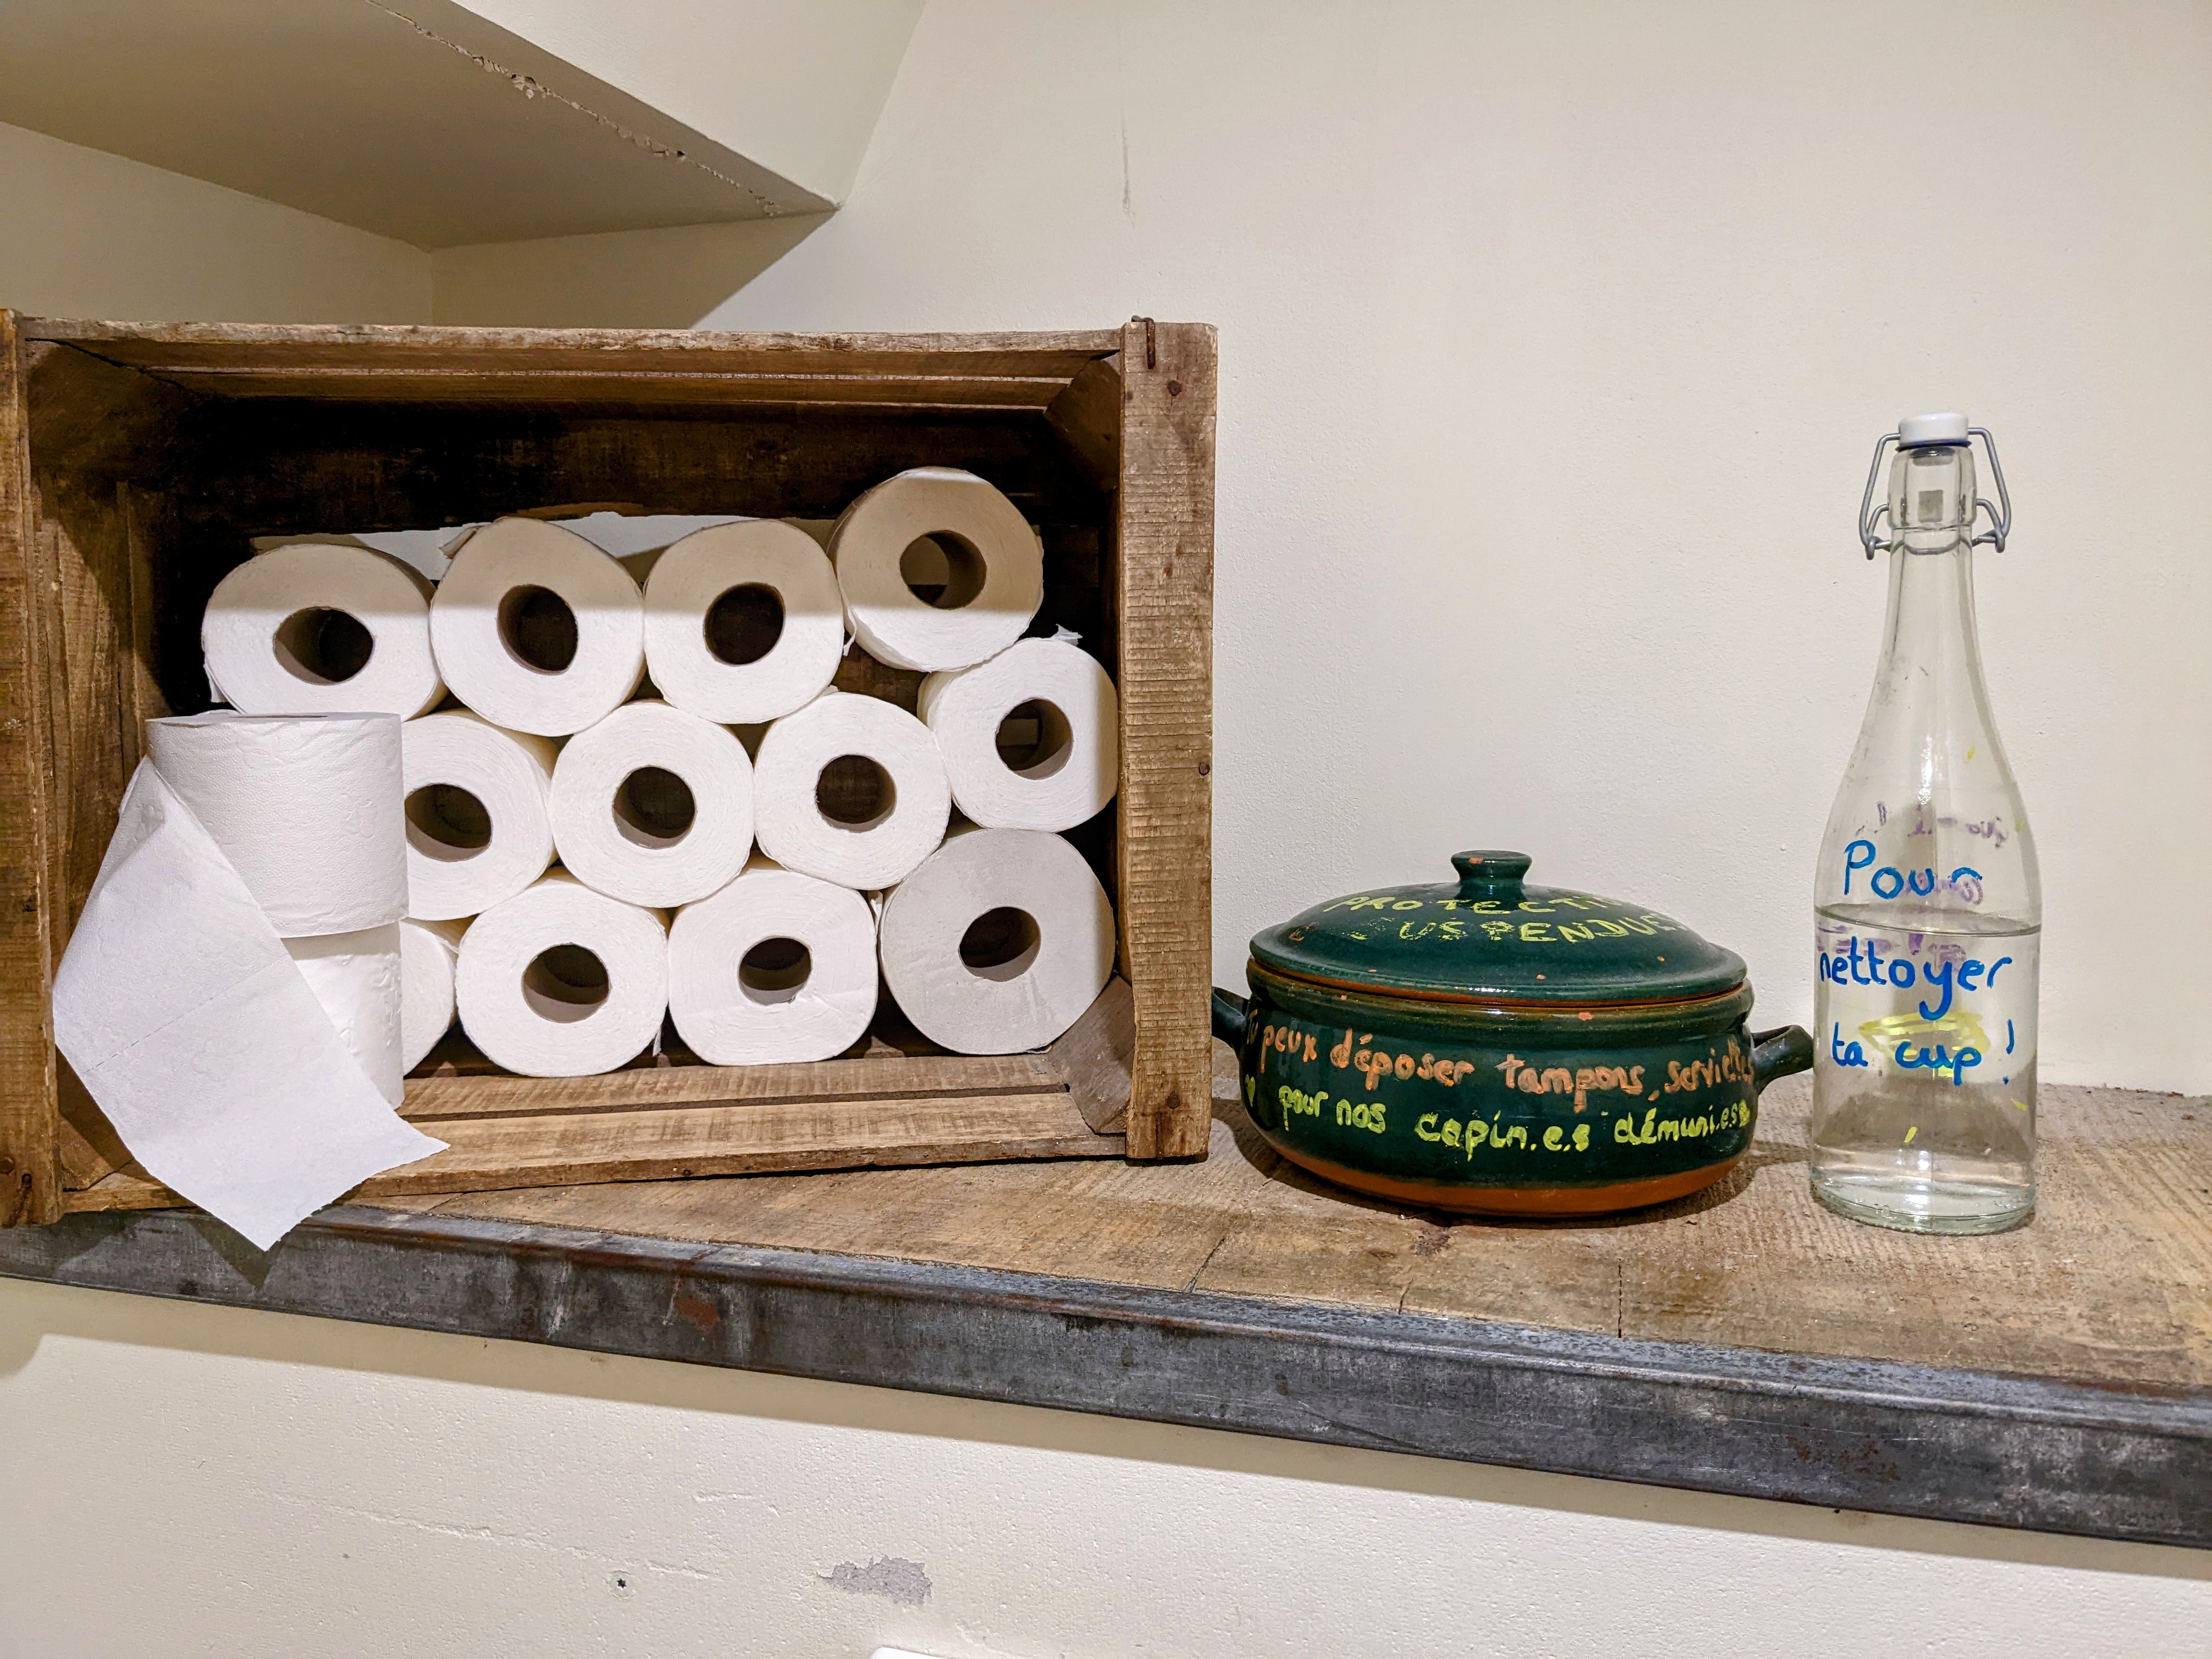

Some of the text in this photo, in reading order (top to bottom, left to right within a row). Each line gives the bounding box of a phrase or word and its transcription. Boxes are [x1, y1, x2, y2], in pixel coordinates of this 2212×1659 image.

[1844, 839, 1983, 900] Pour
[1819, 935, 2013, 1020] nettoyer
[1260, 1024, 1318, 1074] peux
[1329, 1027, 1476, 1091] déposer
[1832, 1021, 1869, 1067] ta
[1894, 1040, 1983, 1087] cup
[1278, 1085, 1329, 1132] pour
[1336, 1098, 1387, 1135] nos
